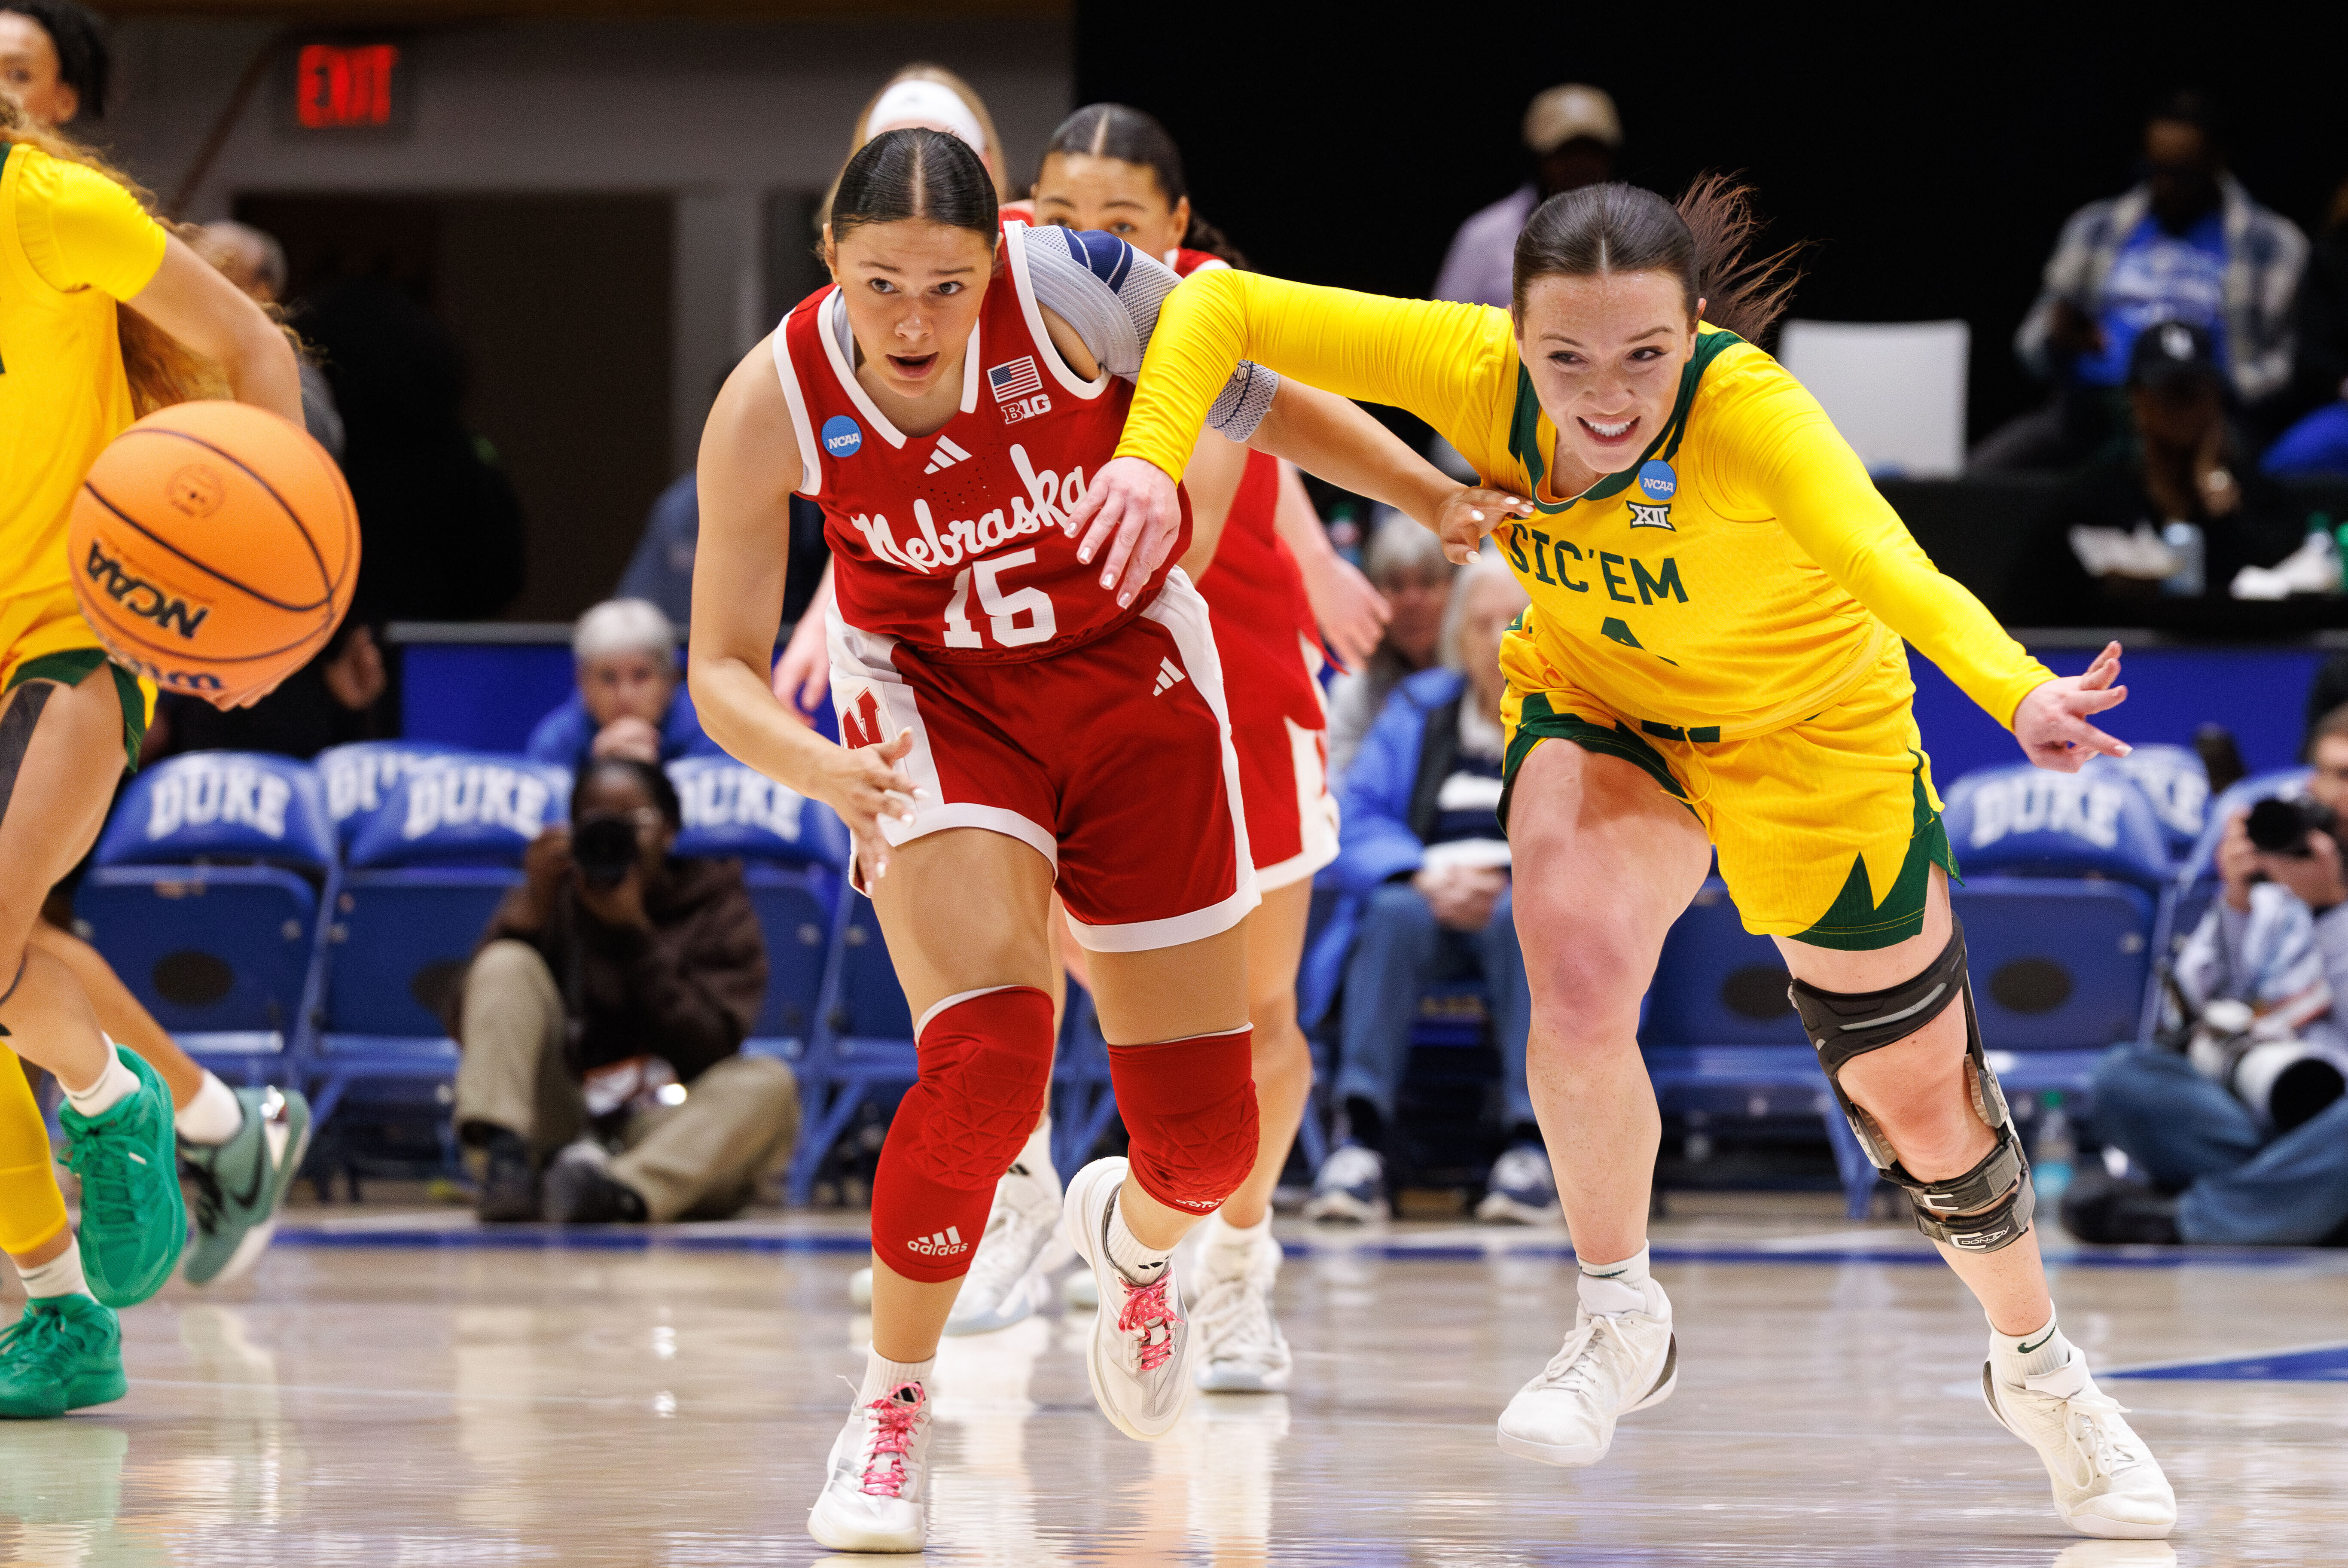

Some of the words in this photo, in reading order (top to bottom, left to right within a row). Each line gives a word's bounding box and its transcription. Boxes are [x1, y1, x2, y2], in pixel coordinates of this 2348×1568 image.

[298, 45, 398, 128] EXIT
[829, 432, 860, 450] NCAA
[851, 444, 1088, 574] Nebraska
[1628, 503, 1674, 529] XII
[1644, 478, 1674, 493] NCAA
[87, 540, 208, 638] NCAA
[943, 547, 1057, 648] 15
[147, 766, 290, 841] DUKE
[404, 766, 548, 840] DUKE
[1972, 775, 2121, 849] DUKE
[907, 1240, 968, 1256] adidas
